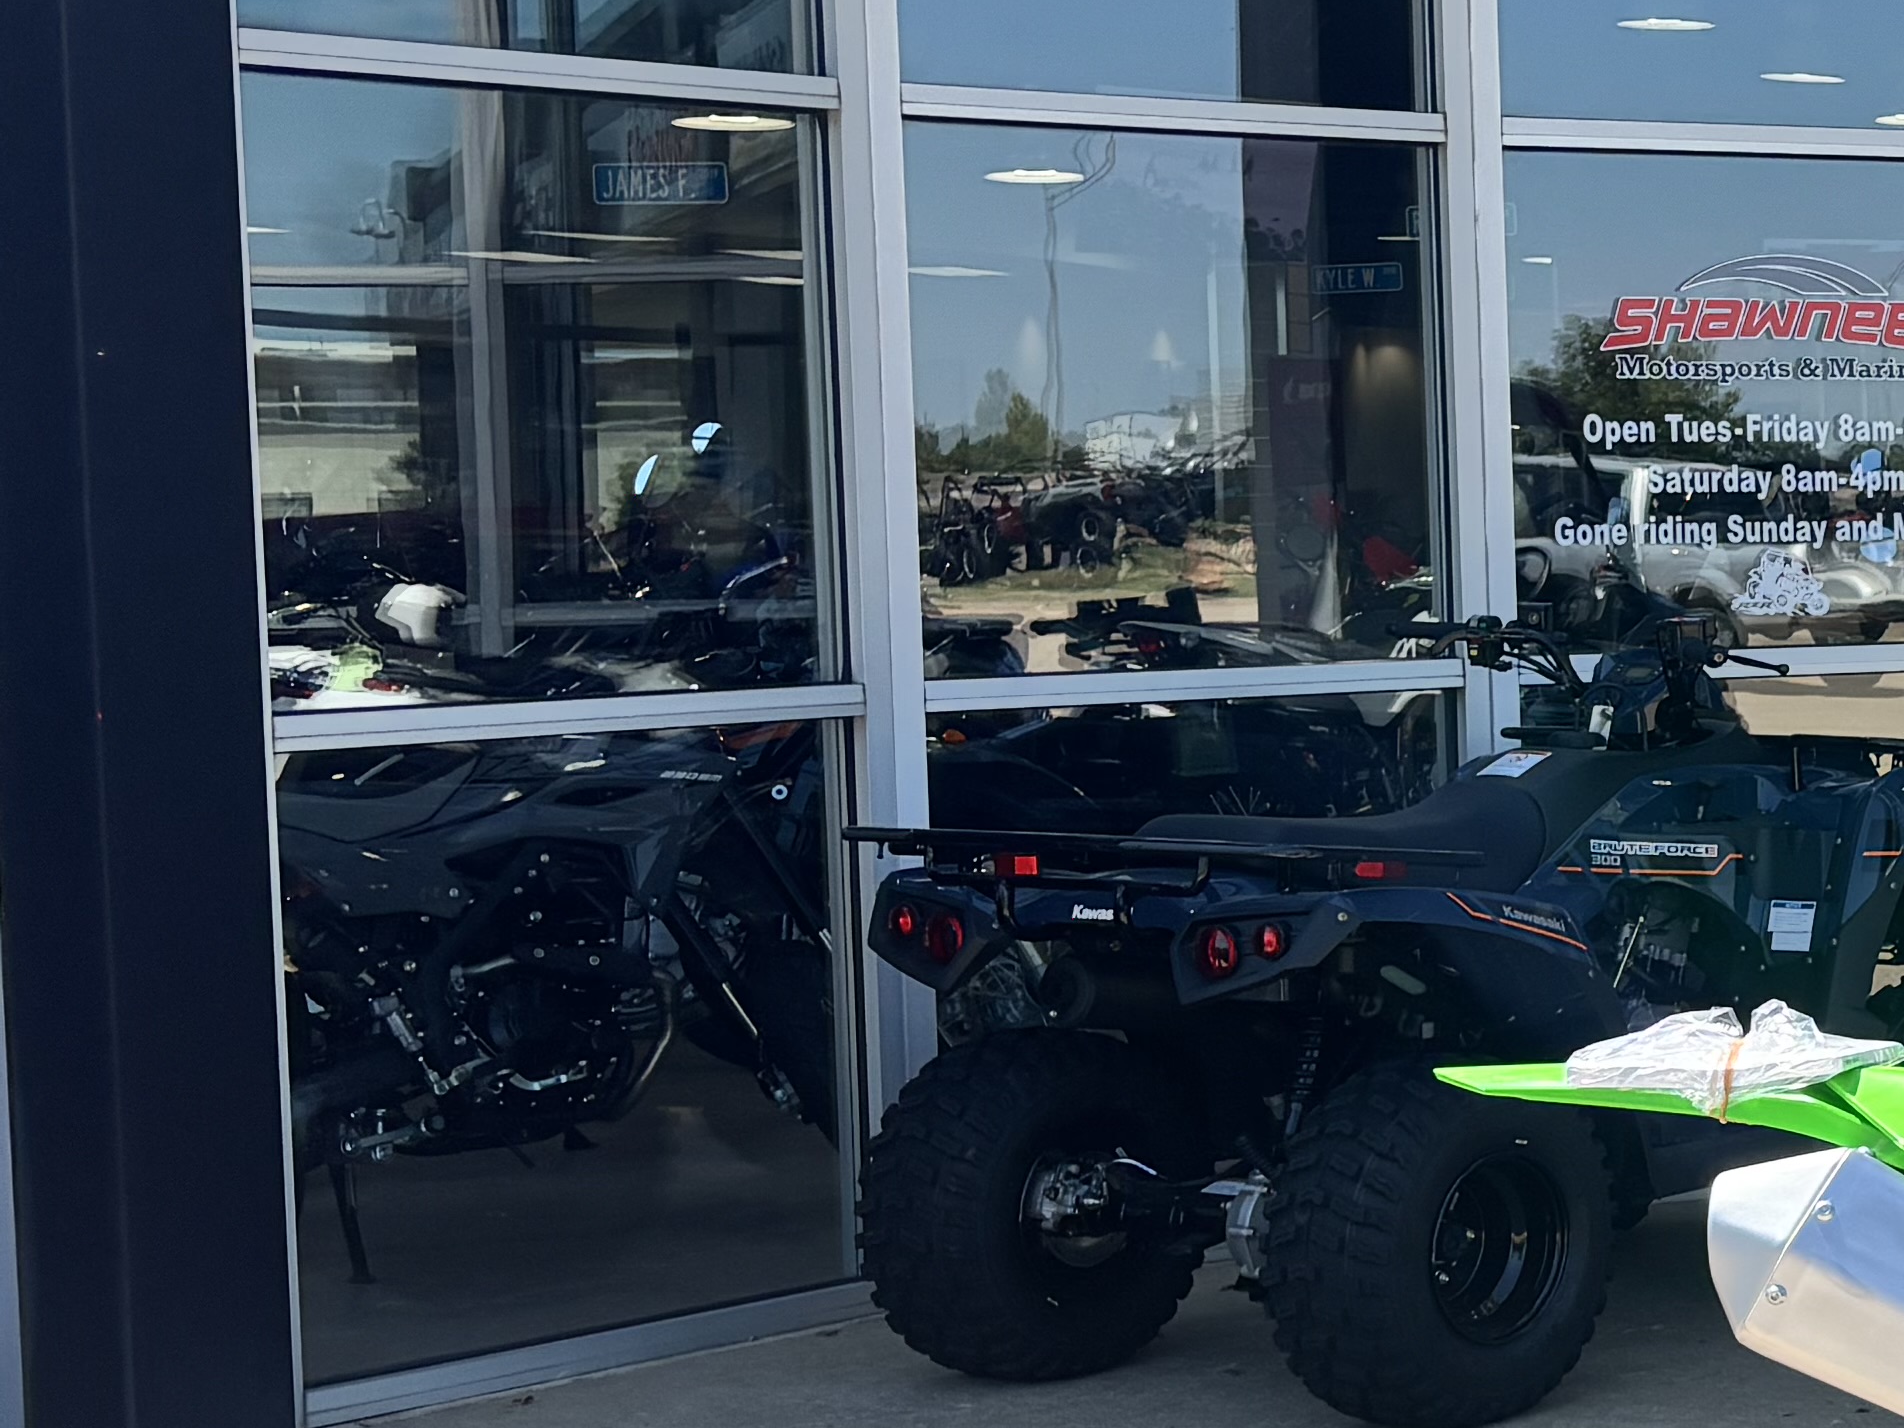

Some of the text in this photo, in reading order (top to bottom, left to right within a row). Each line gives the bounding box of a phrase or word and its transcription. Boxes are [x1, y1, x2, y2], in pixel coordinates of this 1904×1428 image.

[603, 169, 669, 199] JAMES
[1315, 268, 1356, 289] KYLE
[1616, 355, 1790, 384] Motorsports
[1800, 358, 1823, 379] &
[1583, 414, 1655, 449] Open
[1665, 414, 1828, 449] Tues-Friday
[1648, 464, 1904, 499] Saturday 8am-4pm
[1554, 517, 1627, 546] Gone
[1633, 515, 1717, 549] riding
[1727, 514, 1825, 549] Sunday
[1835, 515, 1884, 542] and
[1590, 839, 1718, 858] BRUTE FORCE
[1591, 855, 1621, 866] 300
[1502, 906, 1565, 932] Kawasaki
